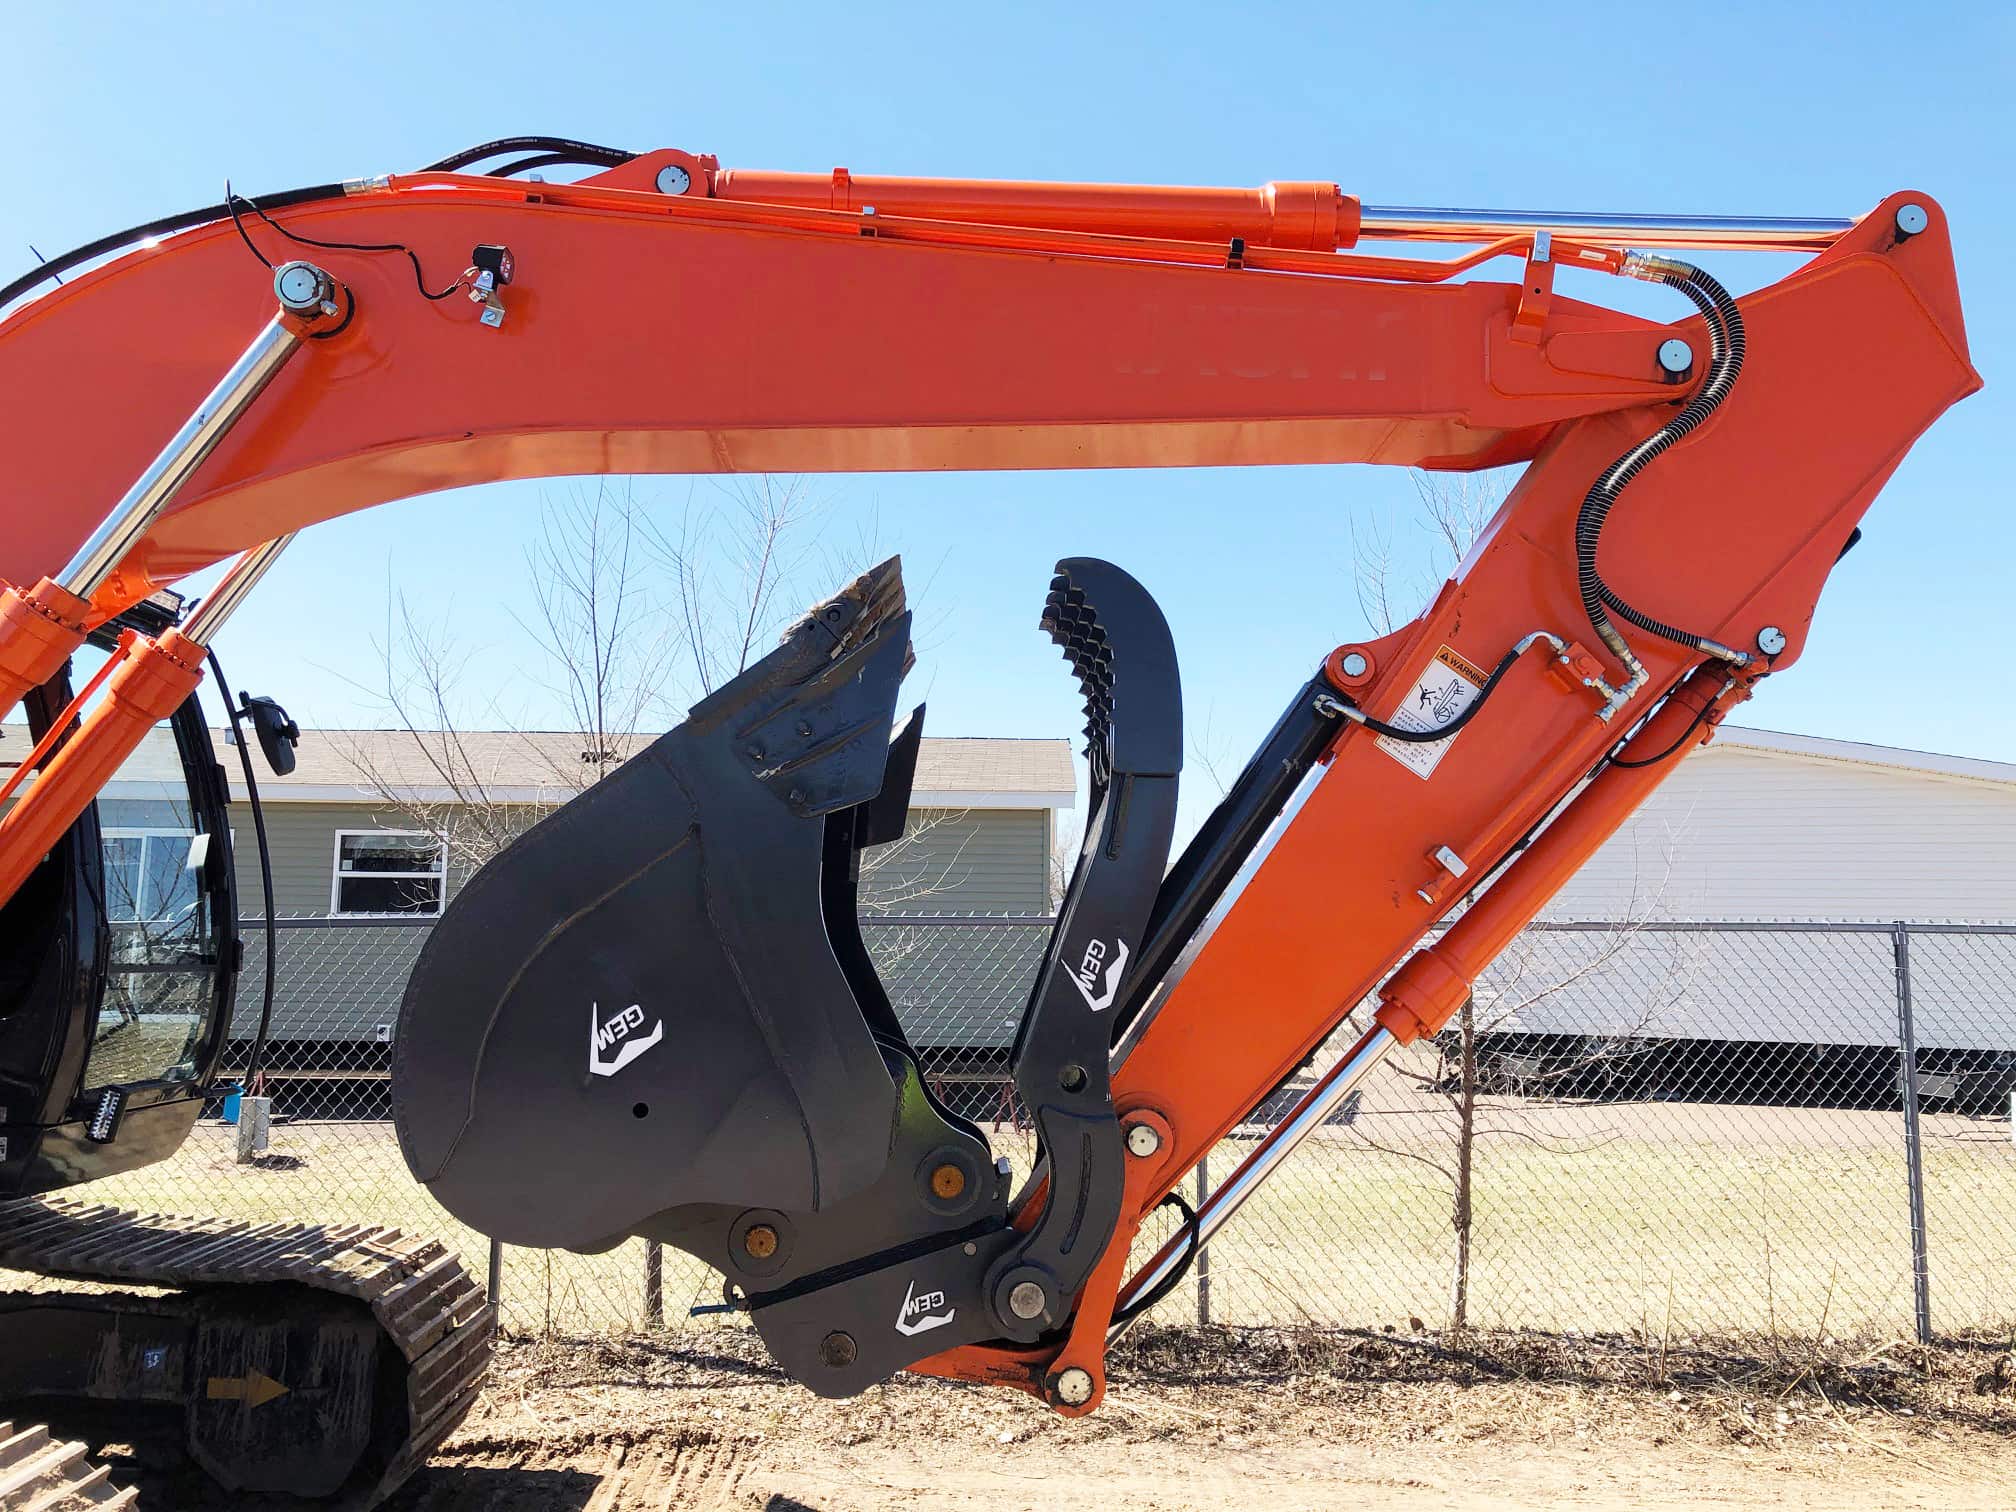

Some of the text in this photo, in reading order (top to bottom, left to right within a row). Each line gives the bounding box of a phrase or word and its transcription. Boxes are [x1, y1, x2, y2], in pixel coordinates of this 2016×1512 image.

[1079, 938, 1107, 991] GEM
[598, 1004, 645, 1051] GEM
[905, 1290, 945, 1317] GEM
